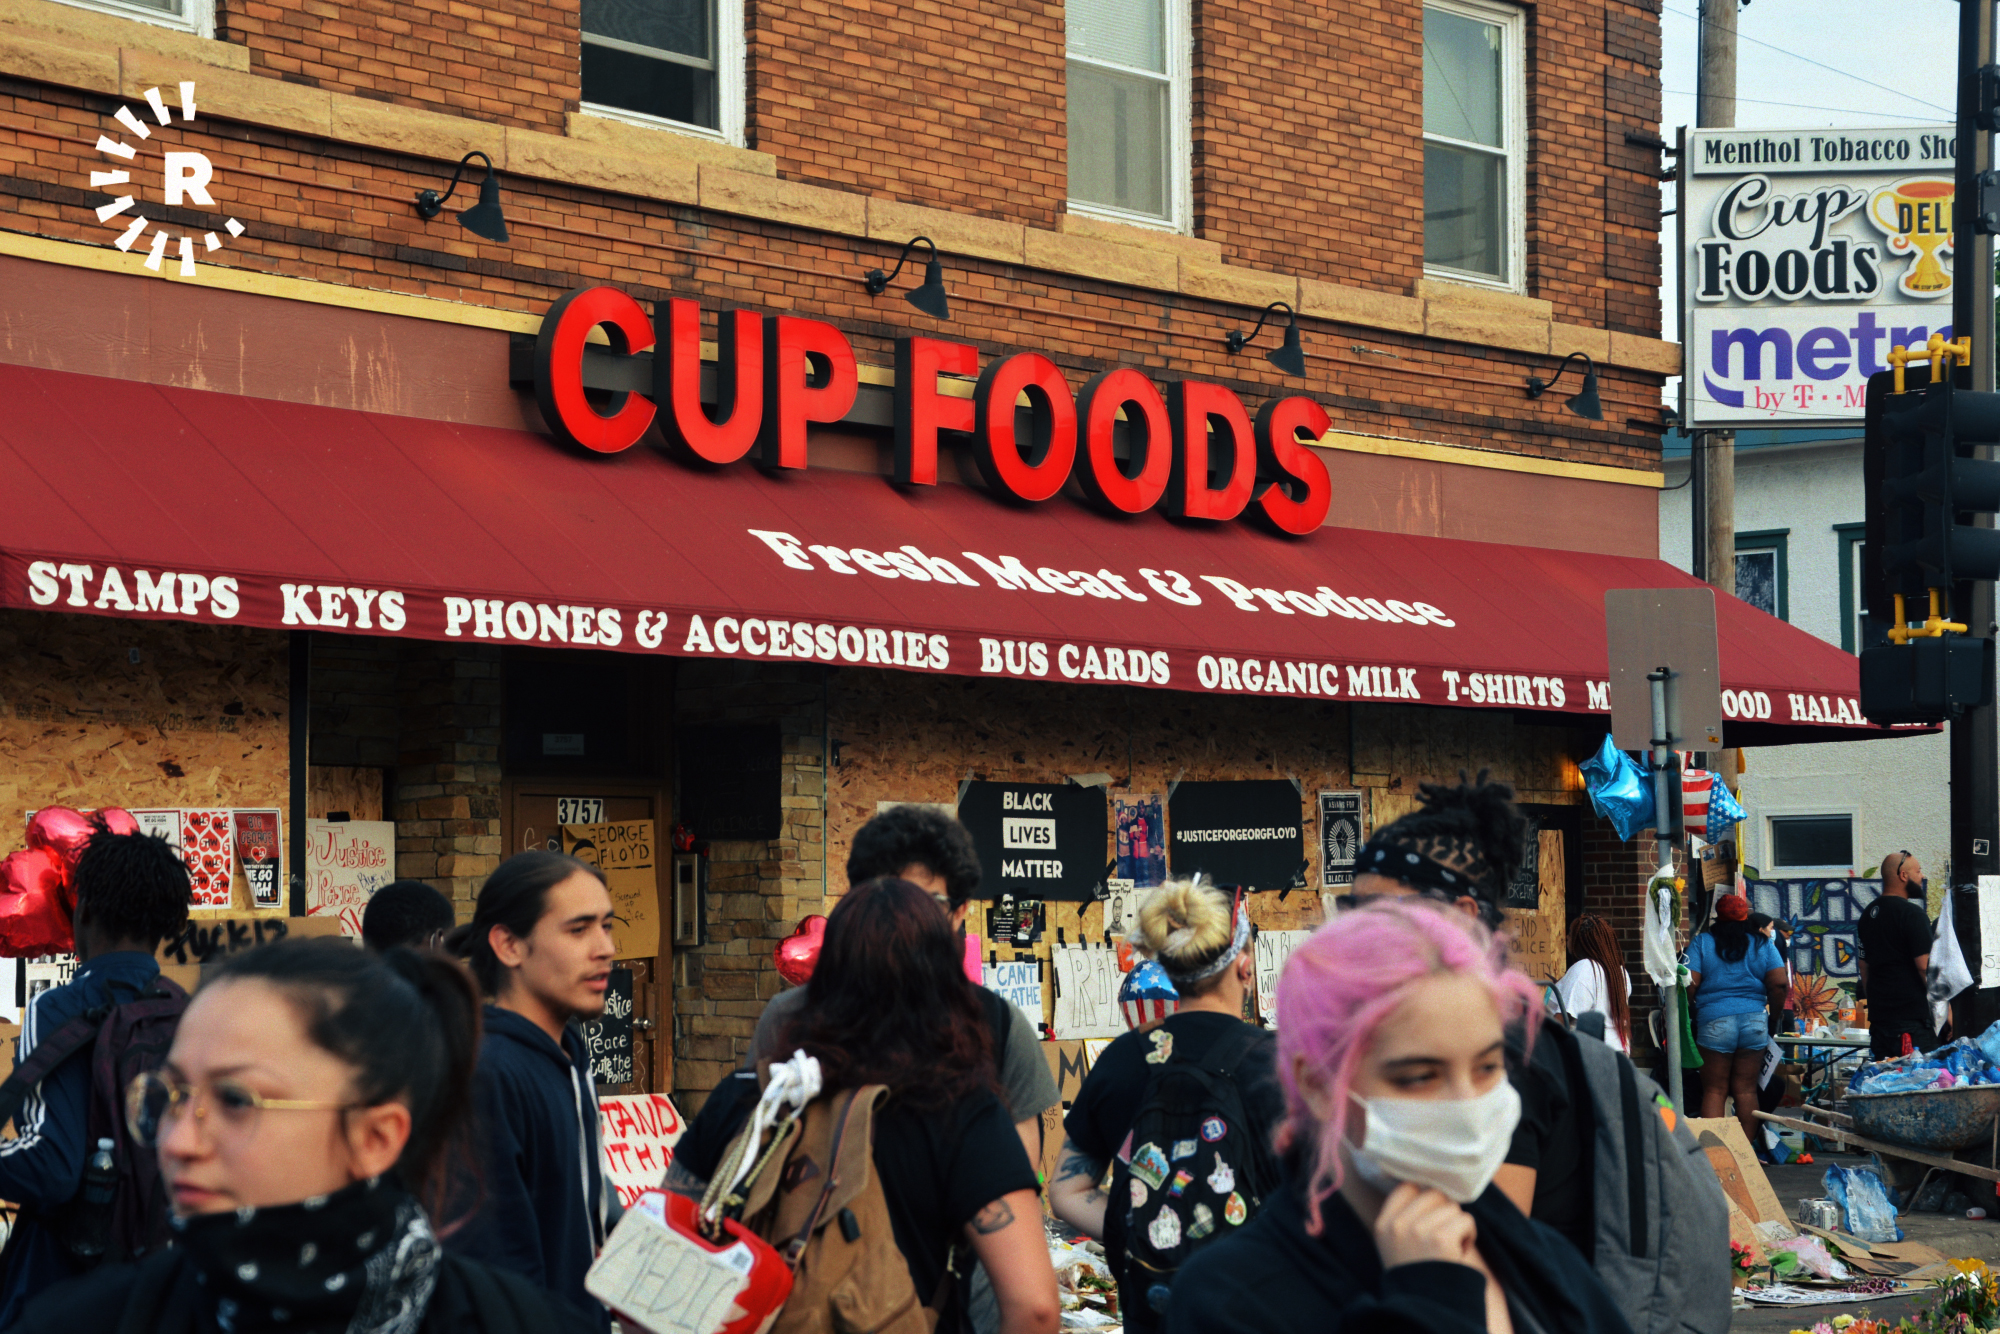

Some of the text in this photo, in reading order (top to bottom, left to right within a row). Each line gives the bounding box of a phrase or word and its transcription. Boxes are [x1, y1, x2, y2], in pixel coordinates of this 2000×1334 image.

[1704, 133, 1957, 164] Menthol Tobacco Sho
[1717, 178, 1863, 252] Cup
[1701, 240, 1878, 296] Foods
[543, 285, 1333, 535] CUP FOODS
[1755, 386, 1786, 416] by
[748, 529, 1456, 628] Fresh Meat & Produce
[27, 561, 240, 619] STAMPS
[280, 583, 407, 632] KEYS
[443, 597, 623, 647] PHONES
[635, 610, 668, 650] &
[683, 614, 950, 671] ACCESSORIES
[979, 637, 1049, 678] BUS
[1057, 644, 1171, 686] CARDS
[1197, 654, 1340, 697] ORGANIC
[1345, 665, 1422, 701] MILK
[1442, 670, 1566, 708] T-SHIRTS
[1722, 689, 1772, 720] OOD
[558, 799, 602, 824] 3757
[1003, 791, 1053, 811] BLACK
[247, 815, 262, 829] BIG
[1010, 826, 1050, 844] LIVES
[240, 831, 273, 844] GEORGE
[316, 826, 387, 868] Justice
[600, 843, 650, 865] FLOYD
[1002, 859, 1063, 878] MATTER
[258, 869, 273, 881] GO
[997, 964, 1037, 987] CANT
[599, 1094, 678, 1139] TAND
[604, 1143, 657, 1173] ITH
